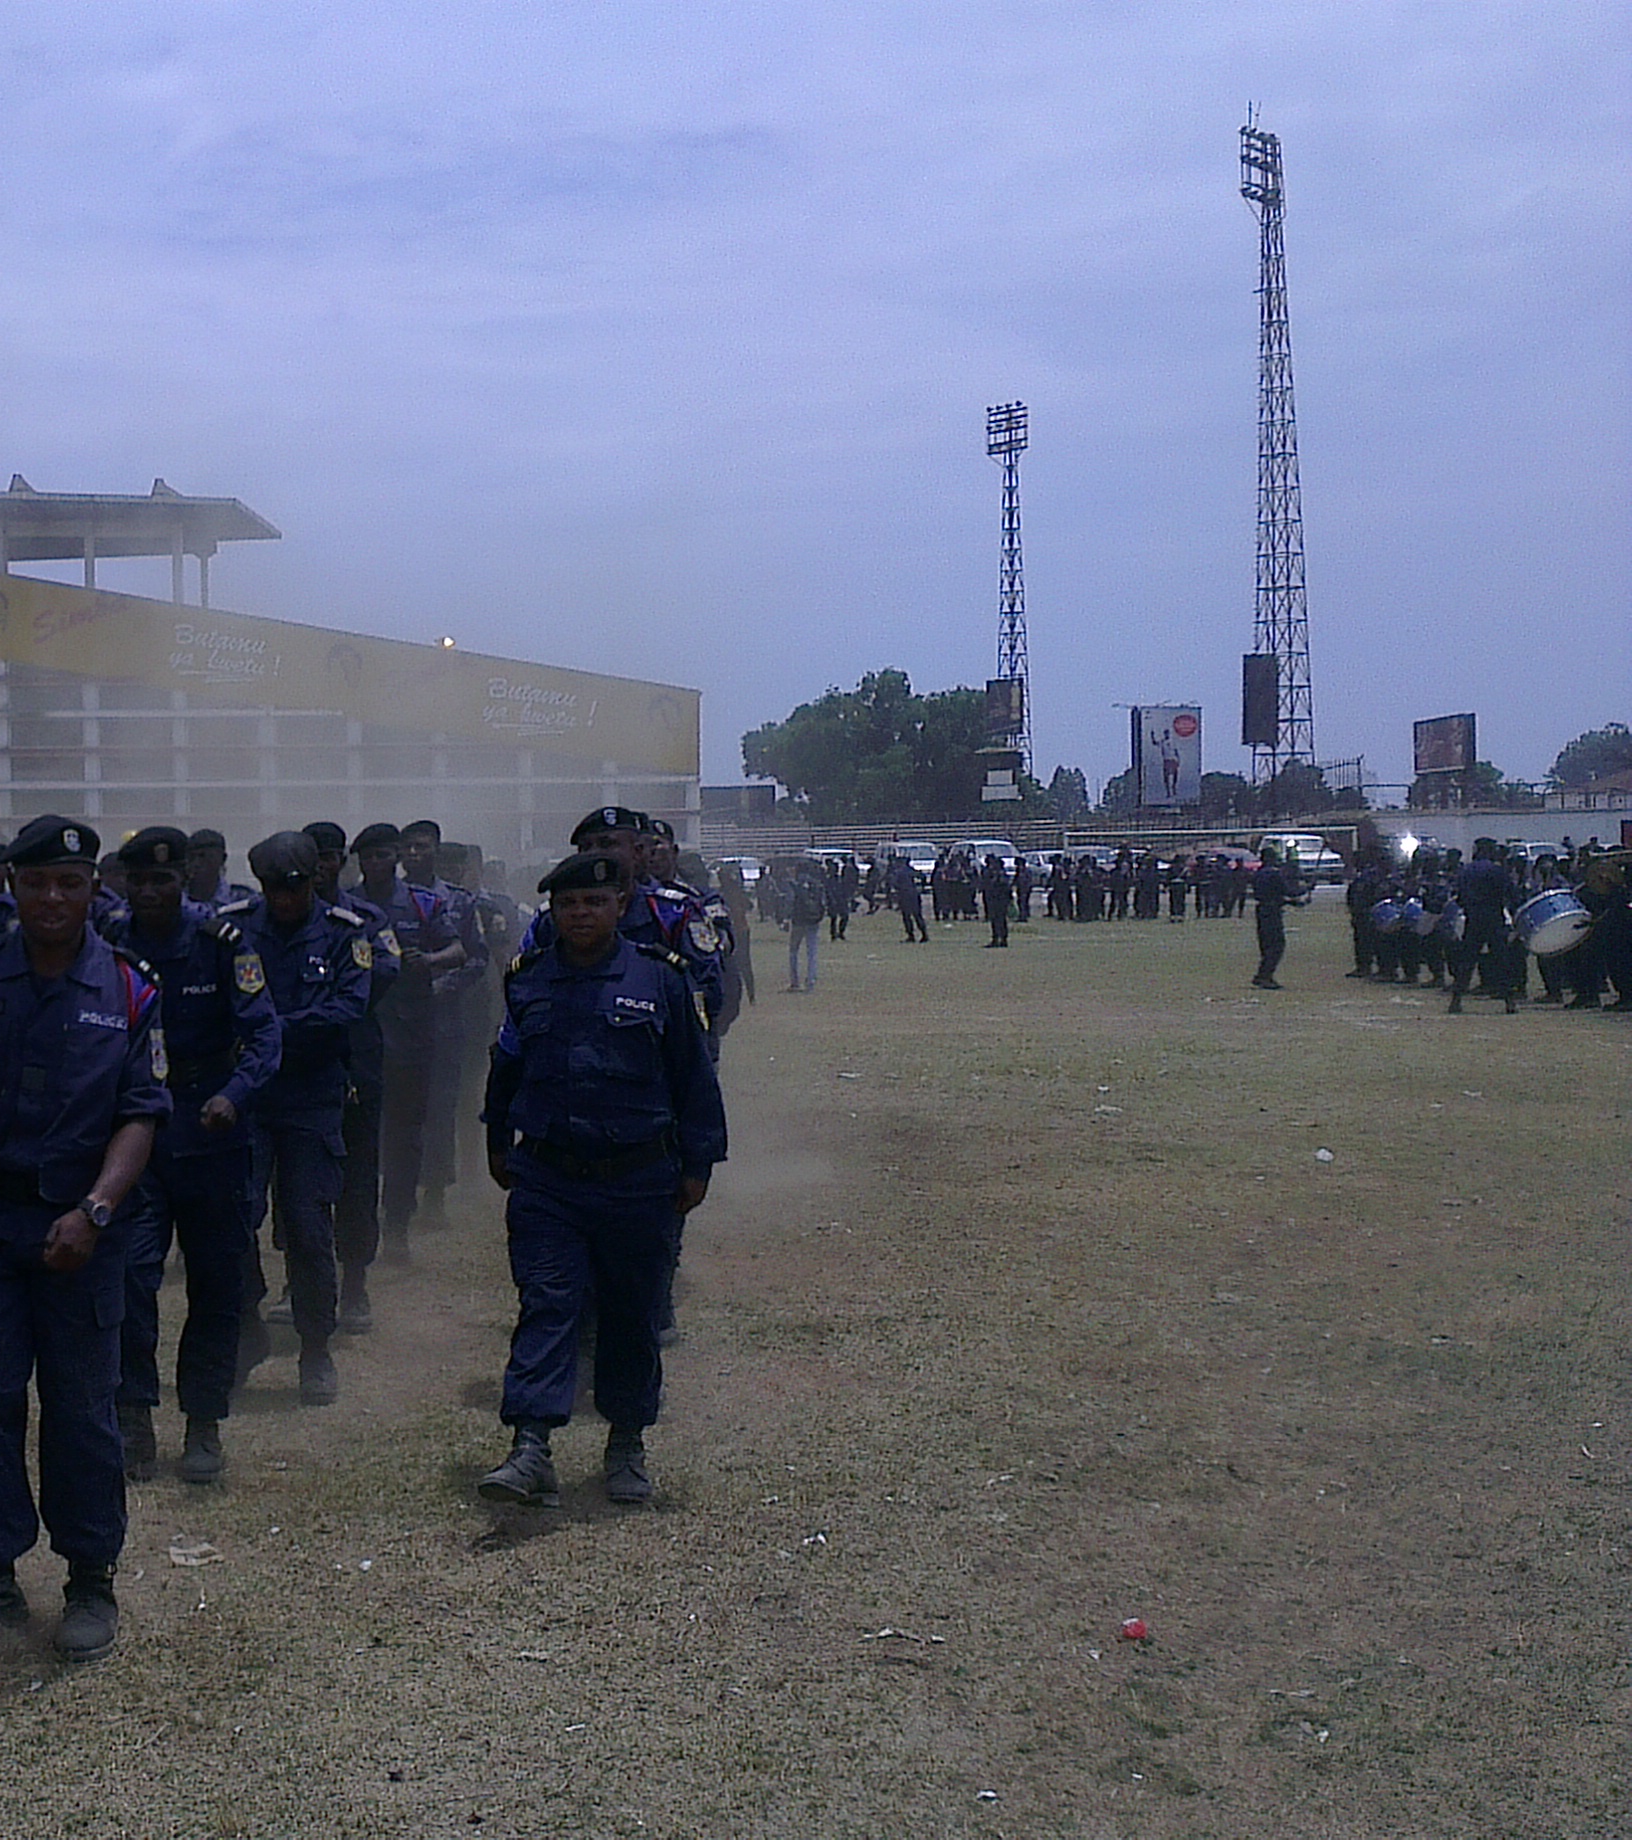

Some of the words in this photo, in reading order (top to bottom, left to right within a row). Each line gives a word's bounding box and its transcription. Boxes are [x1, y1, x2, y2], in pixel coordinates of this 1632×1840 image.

[182, 984, 217, 995] POLICE
[615, 996, 656, 1012] POLICE
[79, 1011, 127, 1030] POLICE
